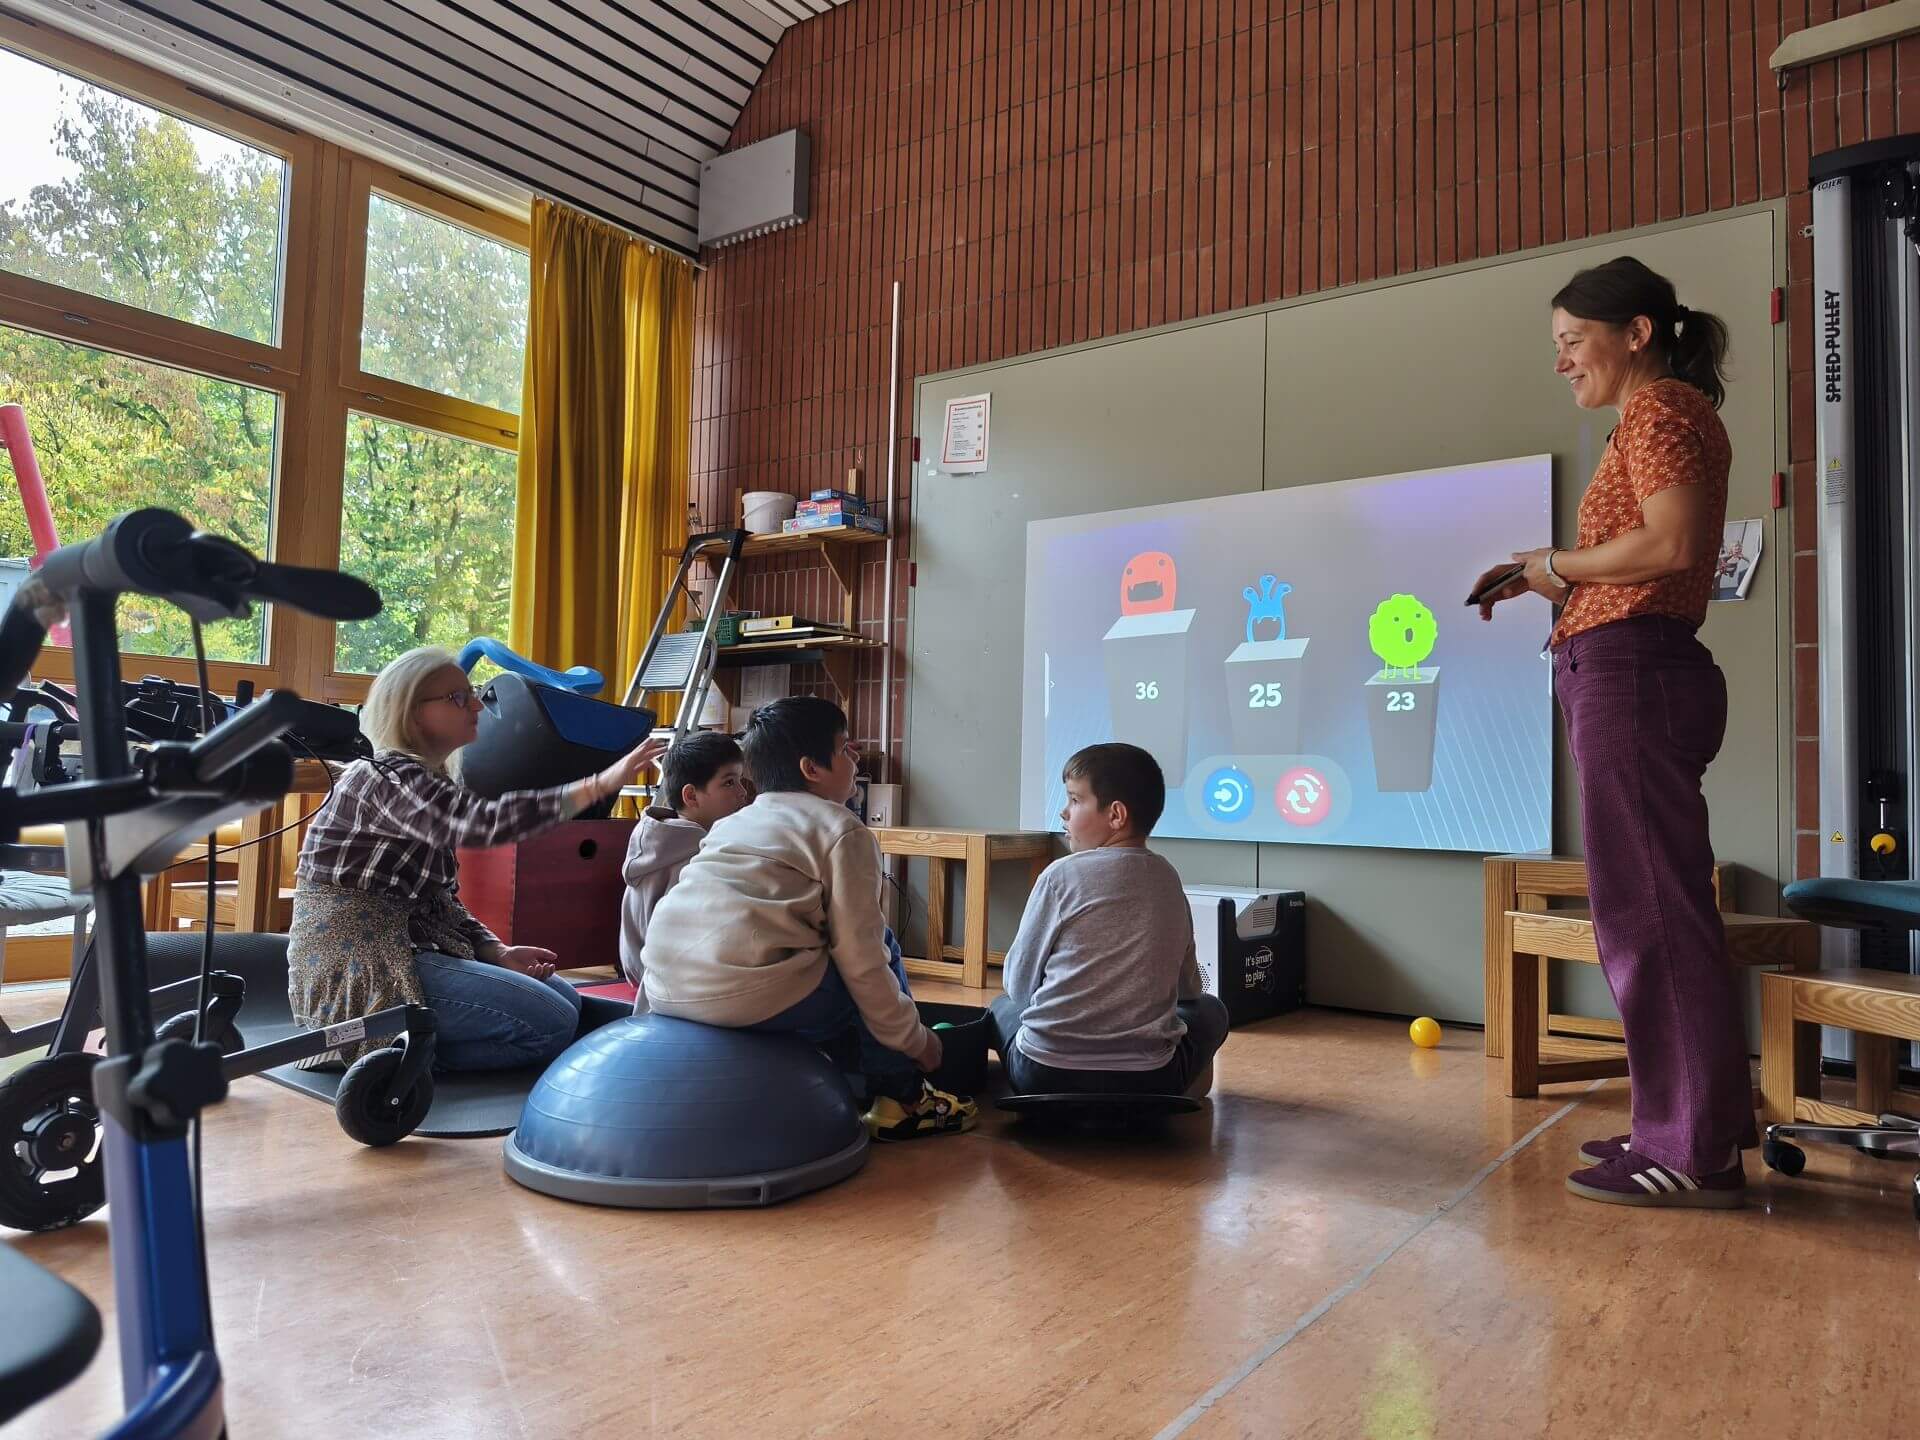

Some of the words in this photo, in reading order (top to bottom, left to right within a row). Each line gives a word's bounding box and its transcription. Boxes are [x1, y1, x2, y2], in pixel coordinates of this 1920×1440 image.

[1135, 681, 1159, 700] 36
[1249, 682, 1282, 708] 25
[1386, 691, 1416, 712] 23
[1245, 955, 1255, 967] It's
[1255, 953, 1272, 965] smart
[1245, 972, 1252, 983] to
